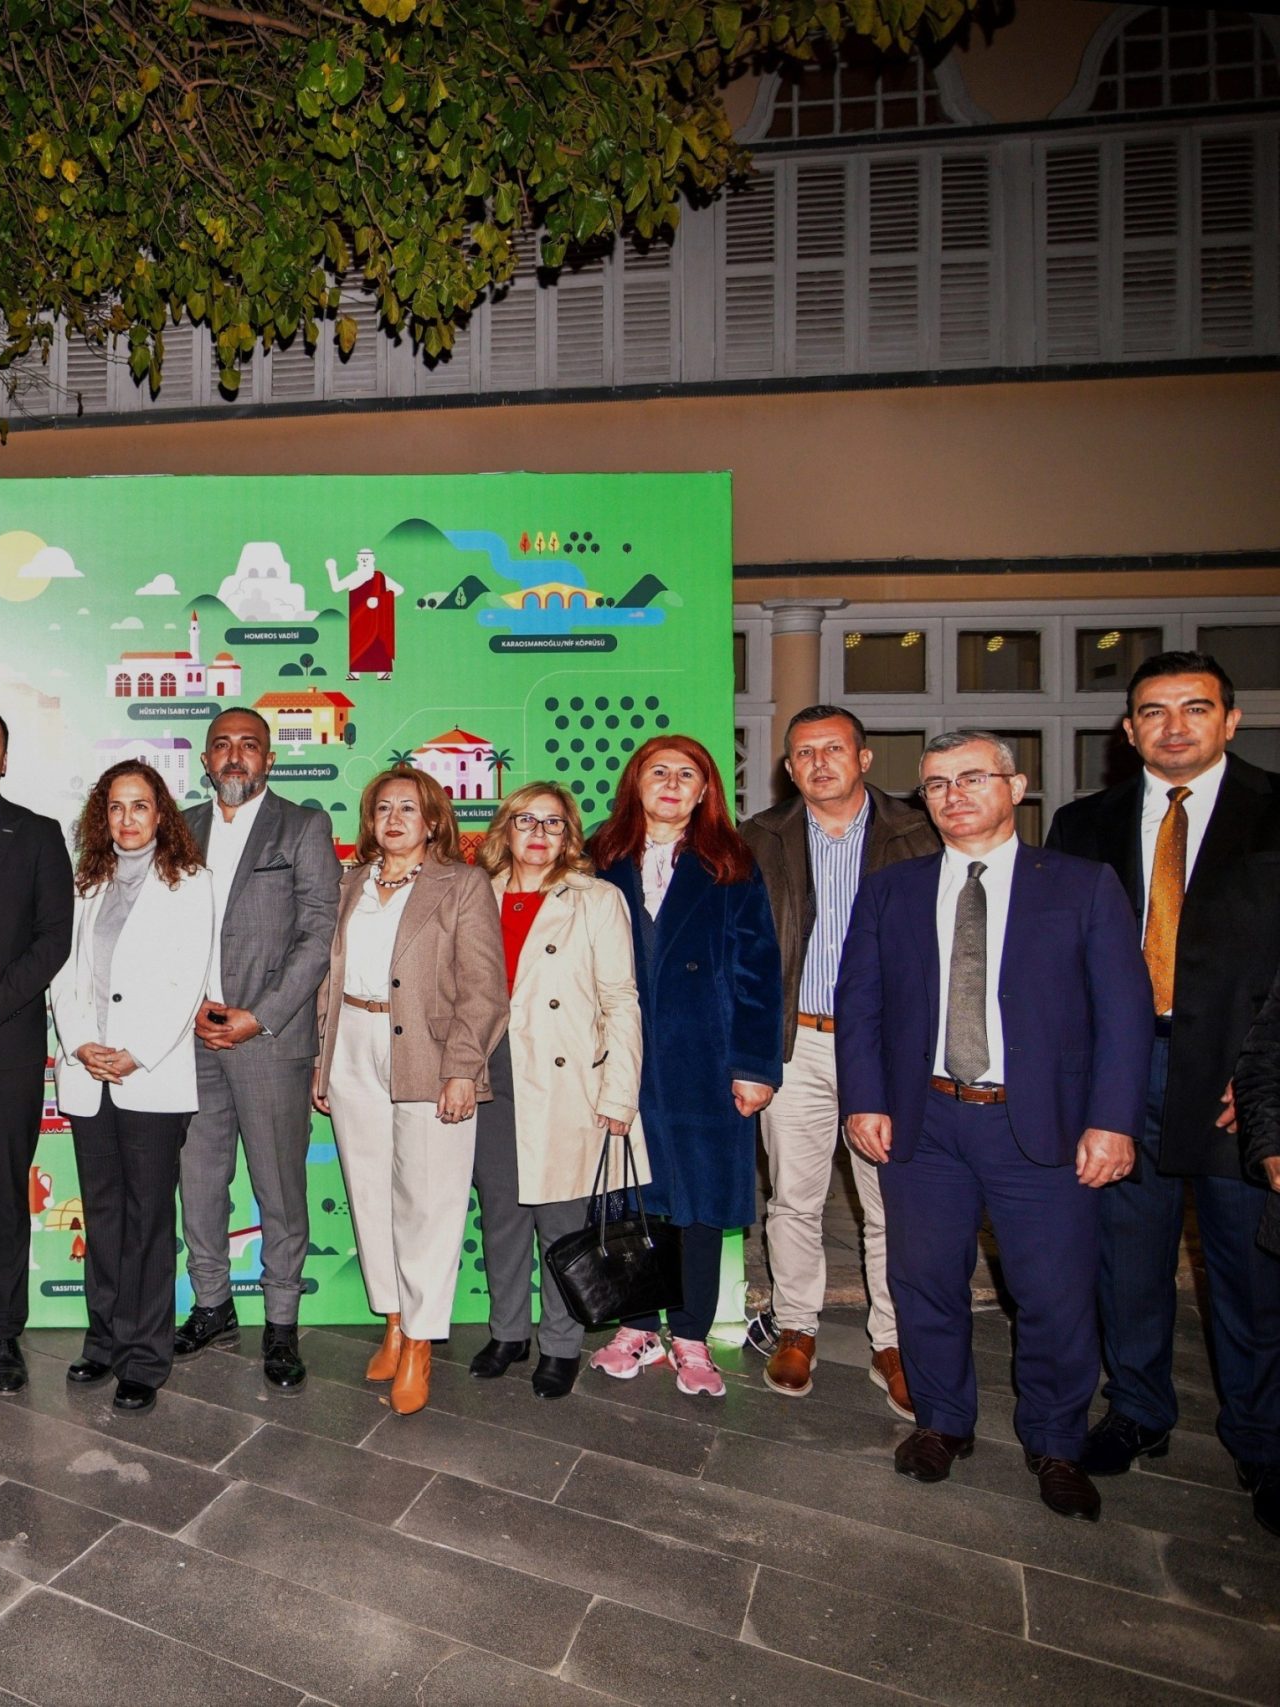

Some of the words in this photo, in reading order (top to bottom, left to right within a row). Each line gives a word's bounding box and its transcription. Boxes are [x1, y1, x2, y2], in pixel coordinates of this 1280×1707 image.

[244, 632, 277, 640] HOMEROS
[278, 631, 299, 639] VADİSİ
[575, 638, 606, 647] KÖPRÜSÜ
[139, 706, 167, 715] HÜSEYİN
